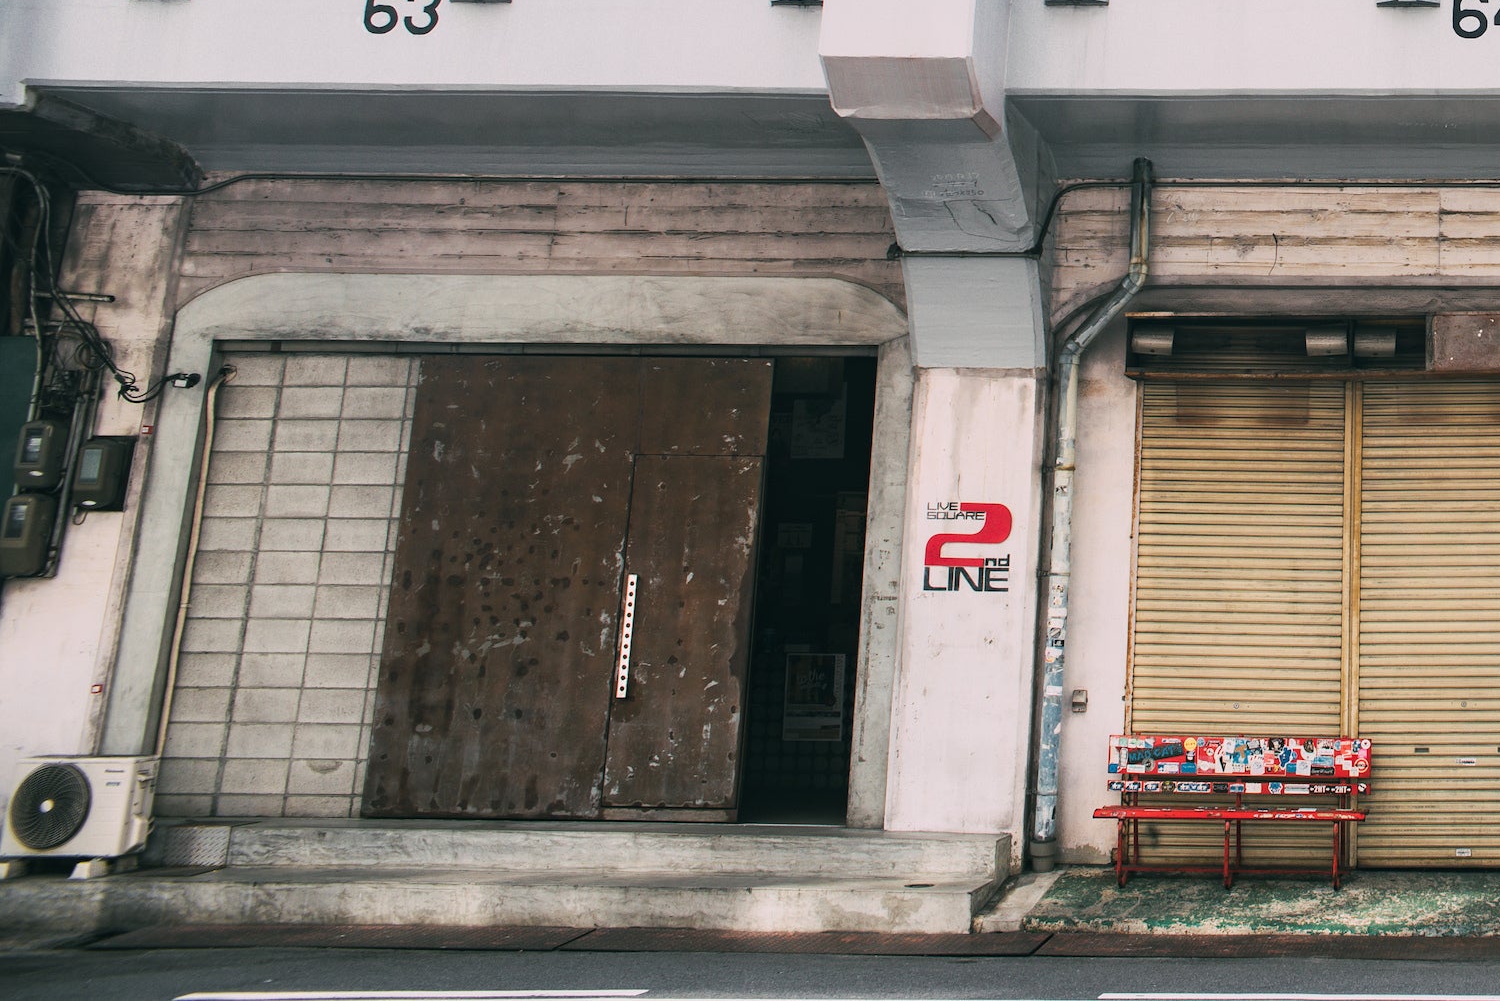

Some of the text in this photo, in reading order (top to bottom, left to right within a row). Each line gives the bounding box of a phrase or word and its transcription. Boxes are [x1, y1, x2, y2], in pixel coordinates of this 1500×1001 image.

[927, 502, 958, 511] LIVE
[927, 511, 985, 520] SQUARE
[923, 567, 1010, 592] LINE
